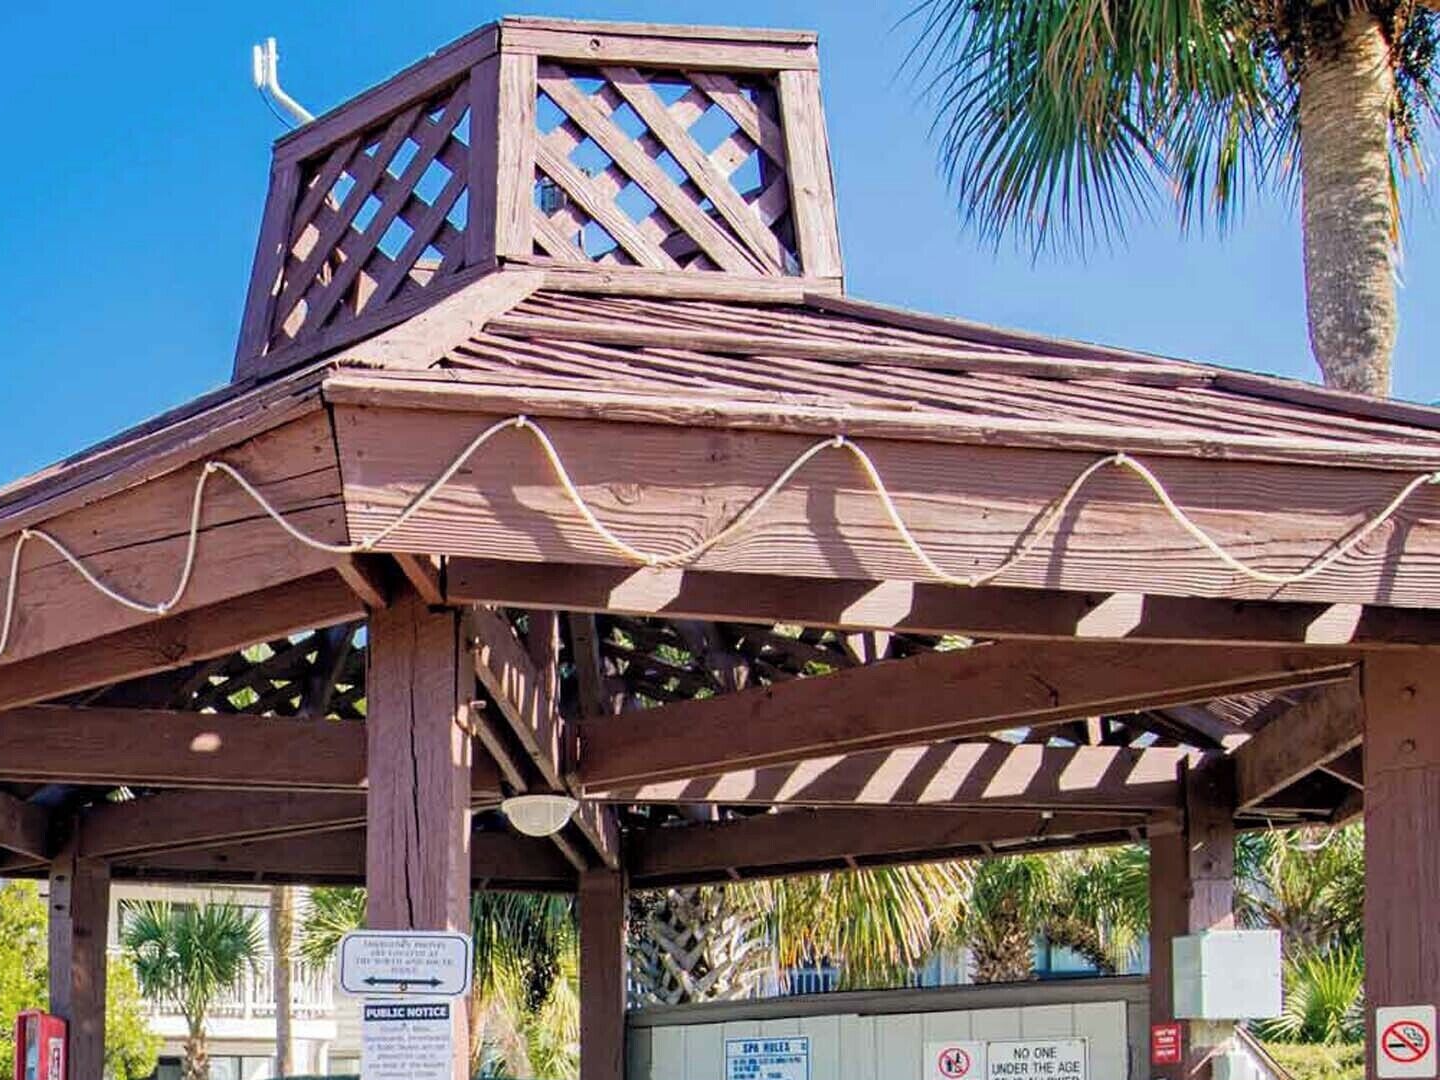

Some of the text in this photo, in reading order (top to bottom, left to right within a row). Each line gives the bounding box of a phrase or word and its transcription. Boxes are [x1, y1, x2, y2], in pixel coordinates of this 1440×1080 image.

[366, 1006, 447, 1018] PUBLIC NOTICE
[743, 1043, 759, 1053] SPA
[763, 1042, 790, 1052] RULES
[1013, 1047, 1057, 1059] NO ONE
[992, 1061, 1080, 1074] UNDER THE AGE
